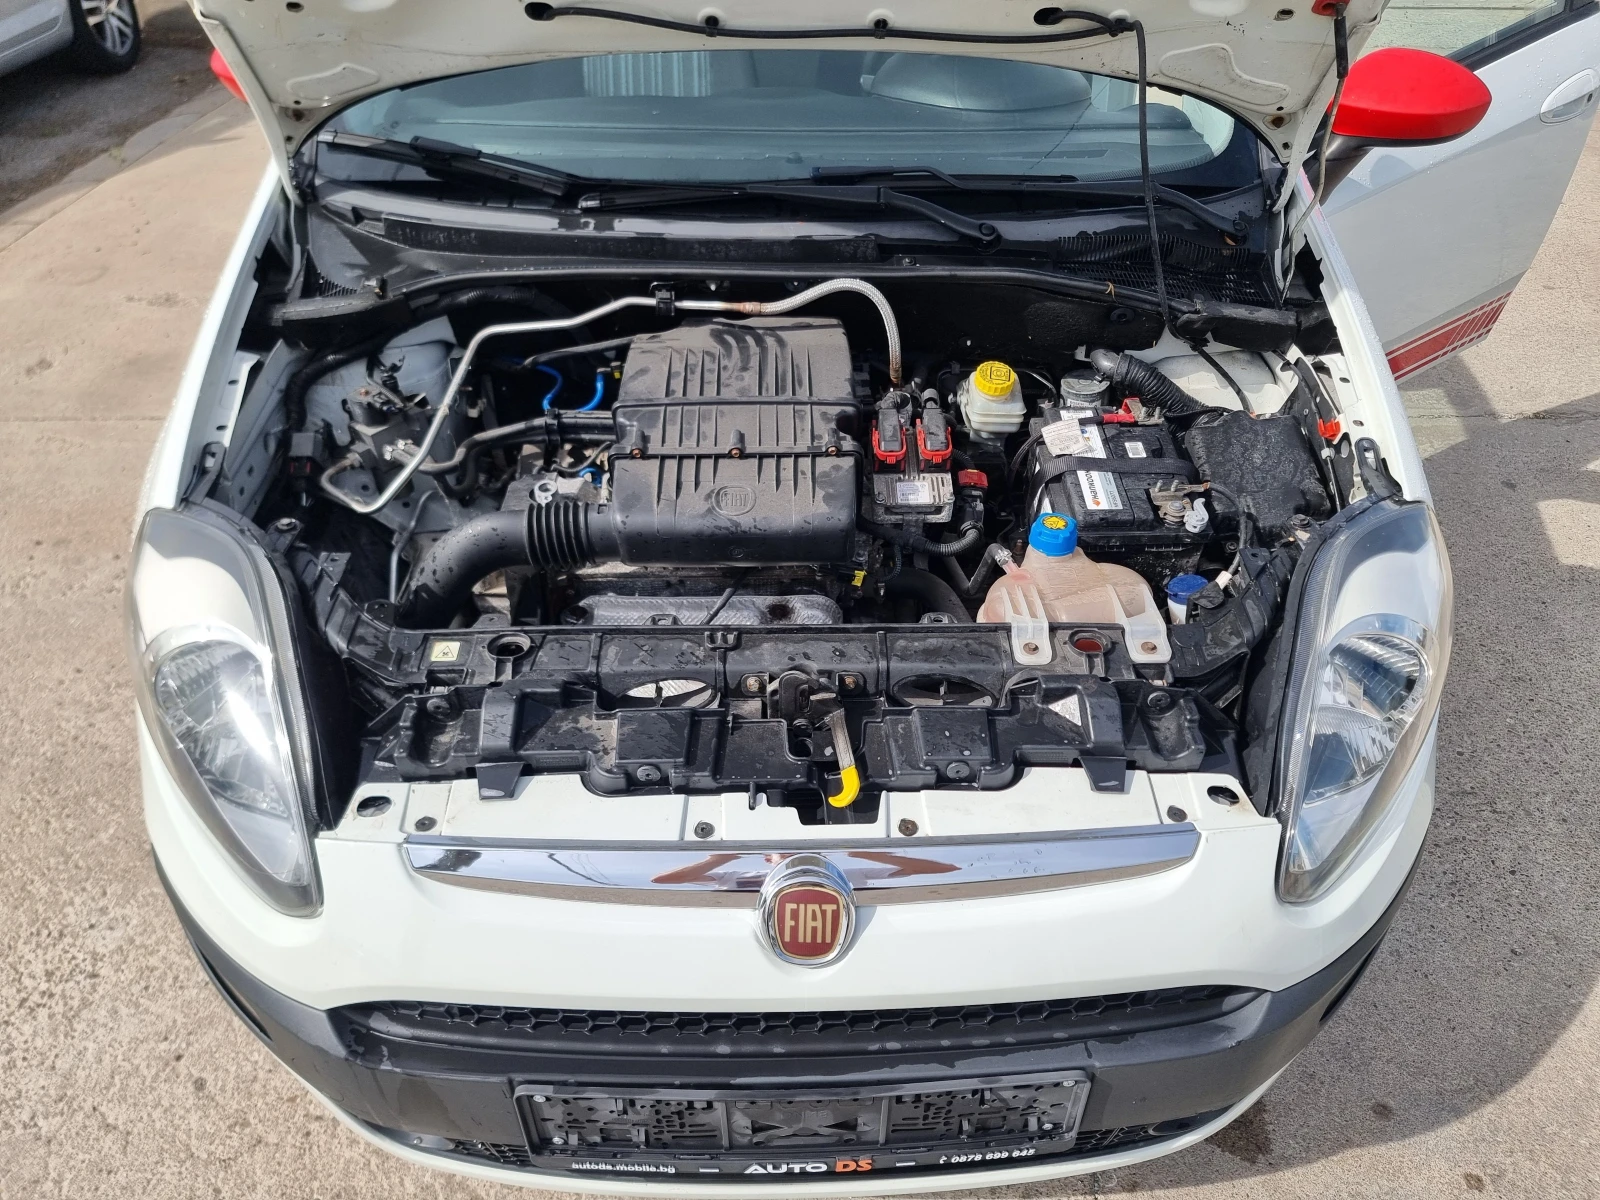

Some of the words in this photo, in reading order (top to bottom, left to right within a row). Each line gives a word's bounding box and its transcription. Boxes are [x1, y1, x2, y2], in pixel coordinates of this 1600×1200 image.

[724, 492, 749, 507] FIAT
[784, 902, 838, 944] FIAT
[951, 1154, 983, 1164] 0878
[985, 1151, 1009, 1161] 699
[1011, 1148, 1036, 1159] 645
[571, 1161, 676, 1174] autods.mobile.bg
[743, 1161, 828, 1174] AUTO
[835, 1158, 873, 1172] DS
